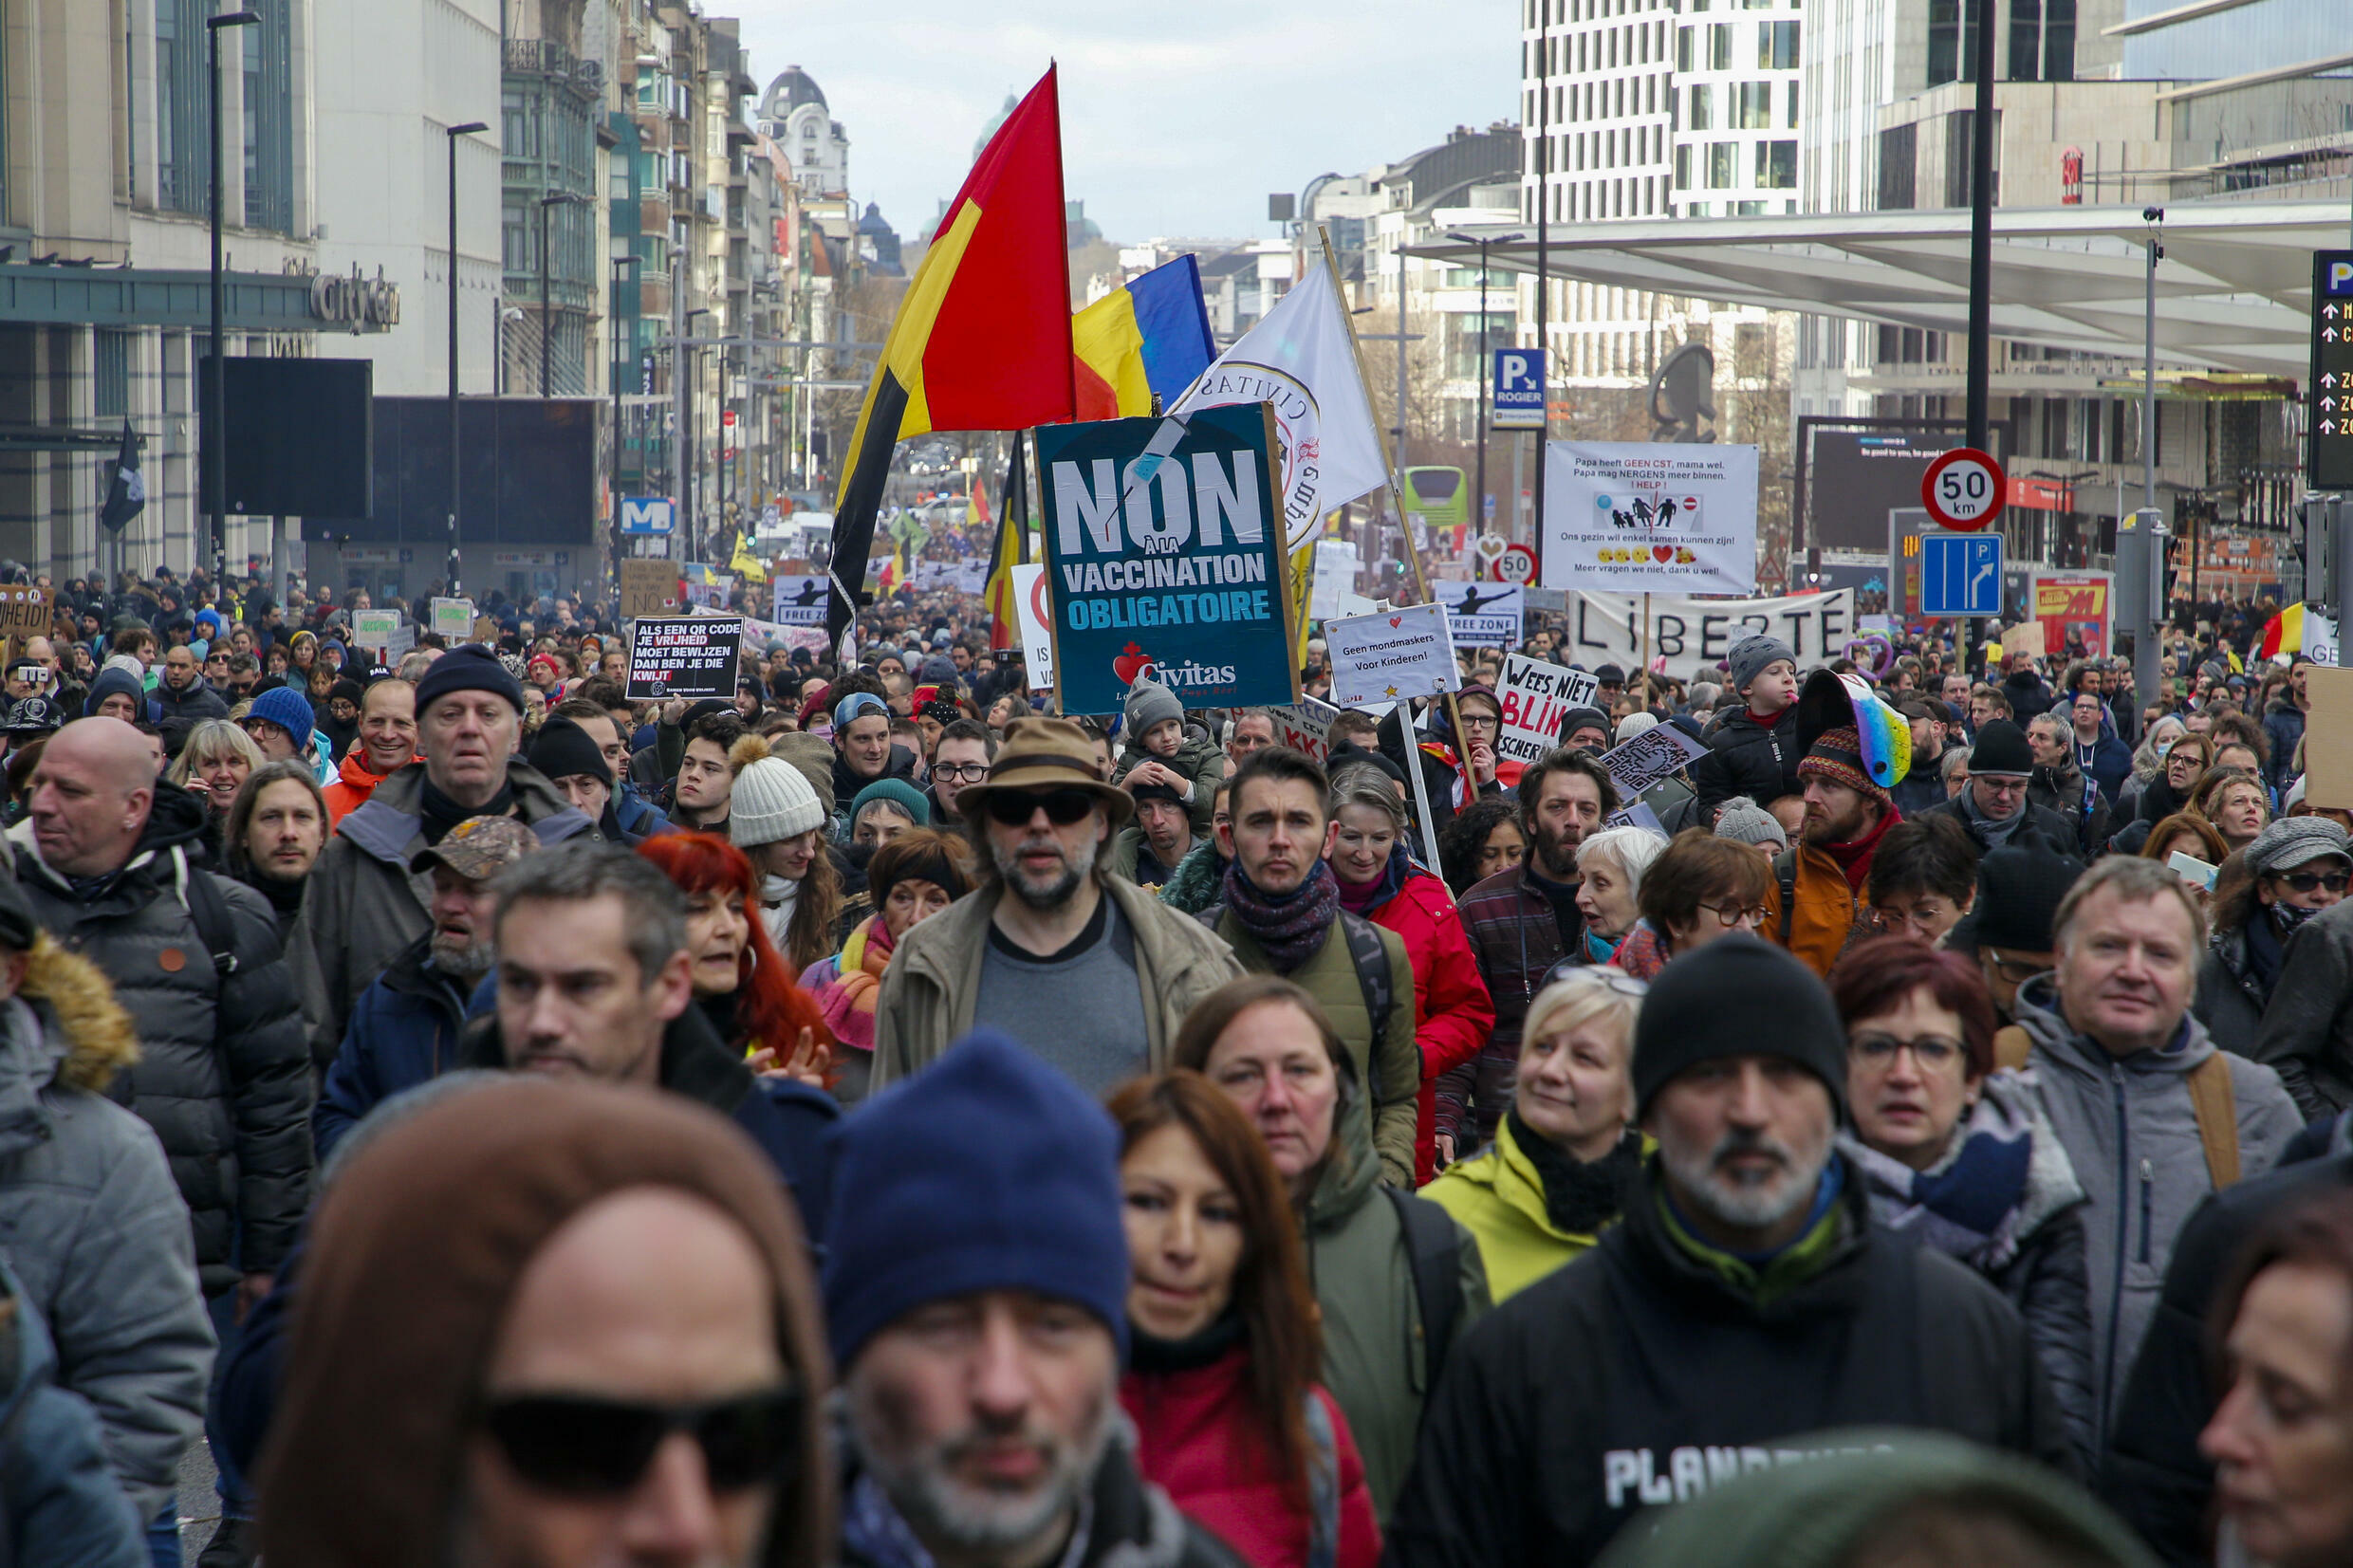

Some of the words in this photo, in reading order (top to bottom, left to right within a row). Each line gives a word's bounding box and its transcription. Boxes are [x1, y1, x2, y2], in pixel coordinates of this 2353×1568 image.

[2343, 326, 2353, 342] C
[1503, 355, 1528, 390] P
[1497, 392, 1542, 402] ROGIER
[1575, 457, 1597, 467] Papa
[1599, 458, 1621, 467] heeft
[1624, 459, 1651, 468] GEEN
[1707, 461, 1725, 470] wel.
[1574, 469, 1596, 478] Papa
[1598, 470, 1617, 480] mag
[1620, 470, 1665, 479] NERGENS
[1693, 471, 1726, 480] binnen.
[1637, 481, 1661, 489] HELP
[1942, 471, 1986, 500] 50
[1051, 449, 1264, 555] NON
[1954, 502, 1975, 515] km
[1159, 537, 1179, 554] LA
[1561, 532, 1579, 541] Ons
[1581, 533, 1605, 543] gezin
[1622, 534, 1647, 543] enkel
[1680, 535, 1714, 544] kunnen
[1716, 536, 1735, 545] zijn!
[1978, 544, 1988, 558] P
[1504, 556, 1528, 572] 50
[1575, 564, 1596, 573] Meer
[1598, 565, 1629, 575] vragen
[1647, 565, 1666, 575] niet,
[1668, 565, 1691, 575] dank
[1701, 566, 1719, 576] wel!
[1063, 552, 1266, 593] VACCINATION
[633, 592, 660, 612] NO
[1067, 589, 1270, 630] OBLIGATOIRE
[786, 610, 811, 620] FREE
[639, 625, 662, 636] ALS
[664, 624, 687, 635] EEN
[689, 624, 707, 636] QR
[709, 623, 741, 635] CODE
[1449, 619, 1474, 629] FREE
[1479, 619, 1511, 630] ZONE
[638, 636, 653, 646] JE
[656, 635, 708, 646] VRIJHEID
[1343, 646, 1367, 655] Geen
[1369, 634, 1435, 652] mondmaskers
[636, 647, 670, 657] MOET
[672, 646, 731, 657] BEWIJZEN
[1037, 647, 1048, 662] IS
[634, 658, 658, 669] DAN
[661, 658, 684, 669] BEN
[687, 658, 702, 669] JE
[705, 657, 724, 669] DIE
[1355, 661, 1379, 671] Voor
[1380, 651, 1428, 668] Kinderen!
[633, 670, 670, 681] KWIJT
[1138, 659, 1236, 687] Civitas
[1507, 659, 1553, 694] WEES
[1268, 706, 1295, 722] VOOR
[1303, 722, 1324, 736] EEN
[1499, 734, 1541, 761] SCHER
